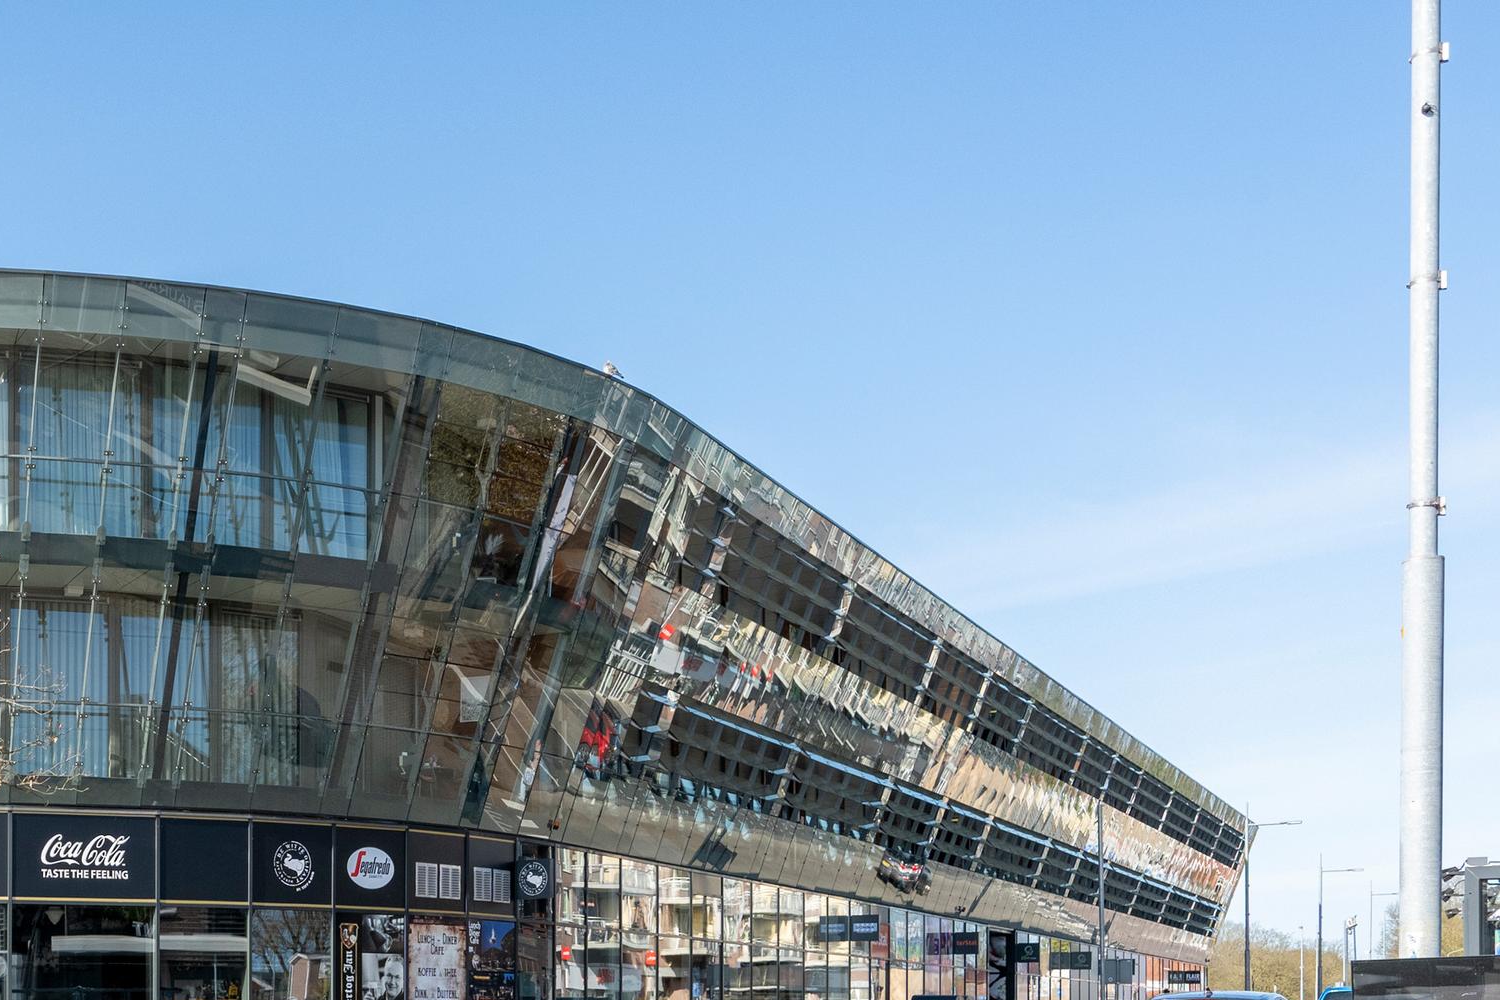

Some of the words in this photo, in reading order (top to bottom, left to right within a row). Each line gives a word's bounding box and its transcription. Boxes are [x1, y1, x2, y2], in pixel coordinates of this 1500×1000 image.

[41, 868, 70, 878] TASTE
[71, 869, 89, 879] THE
[91, 870, 129, 880] FEELING
[350, 850, 391, 877] Segafredo
[343, 949, 356, 974] Jan
